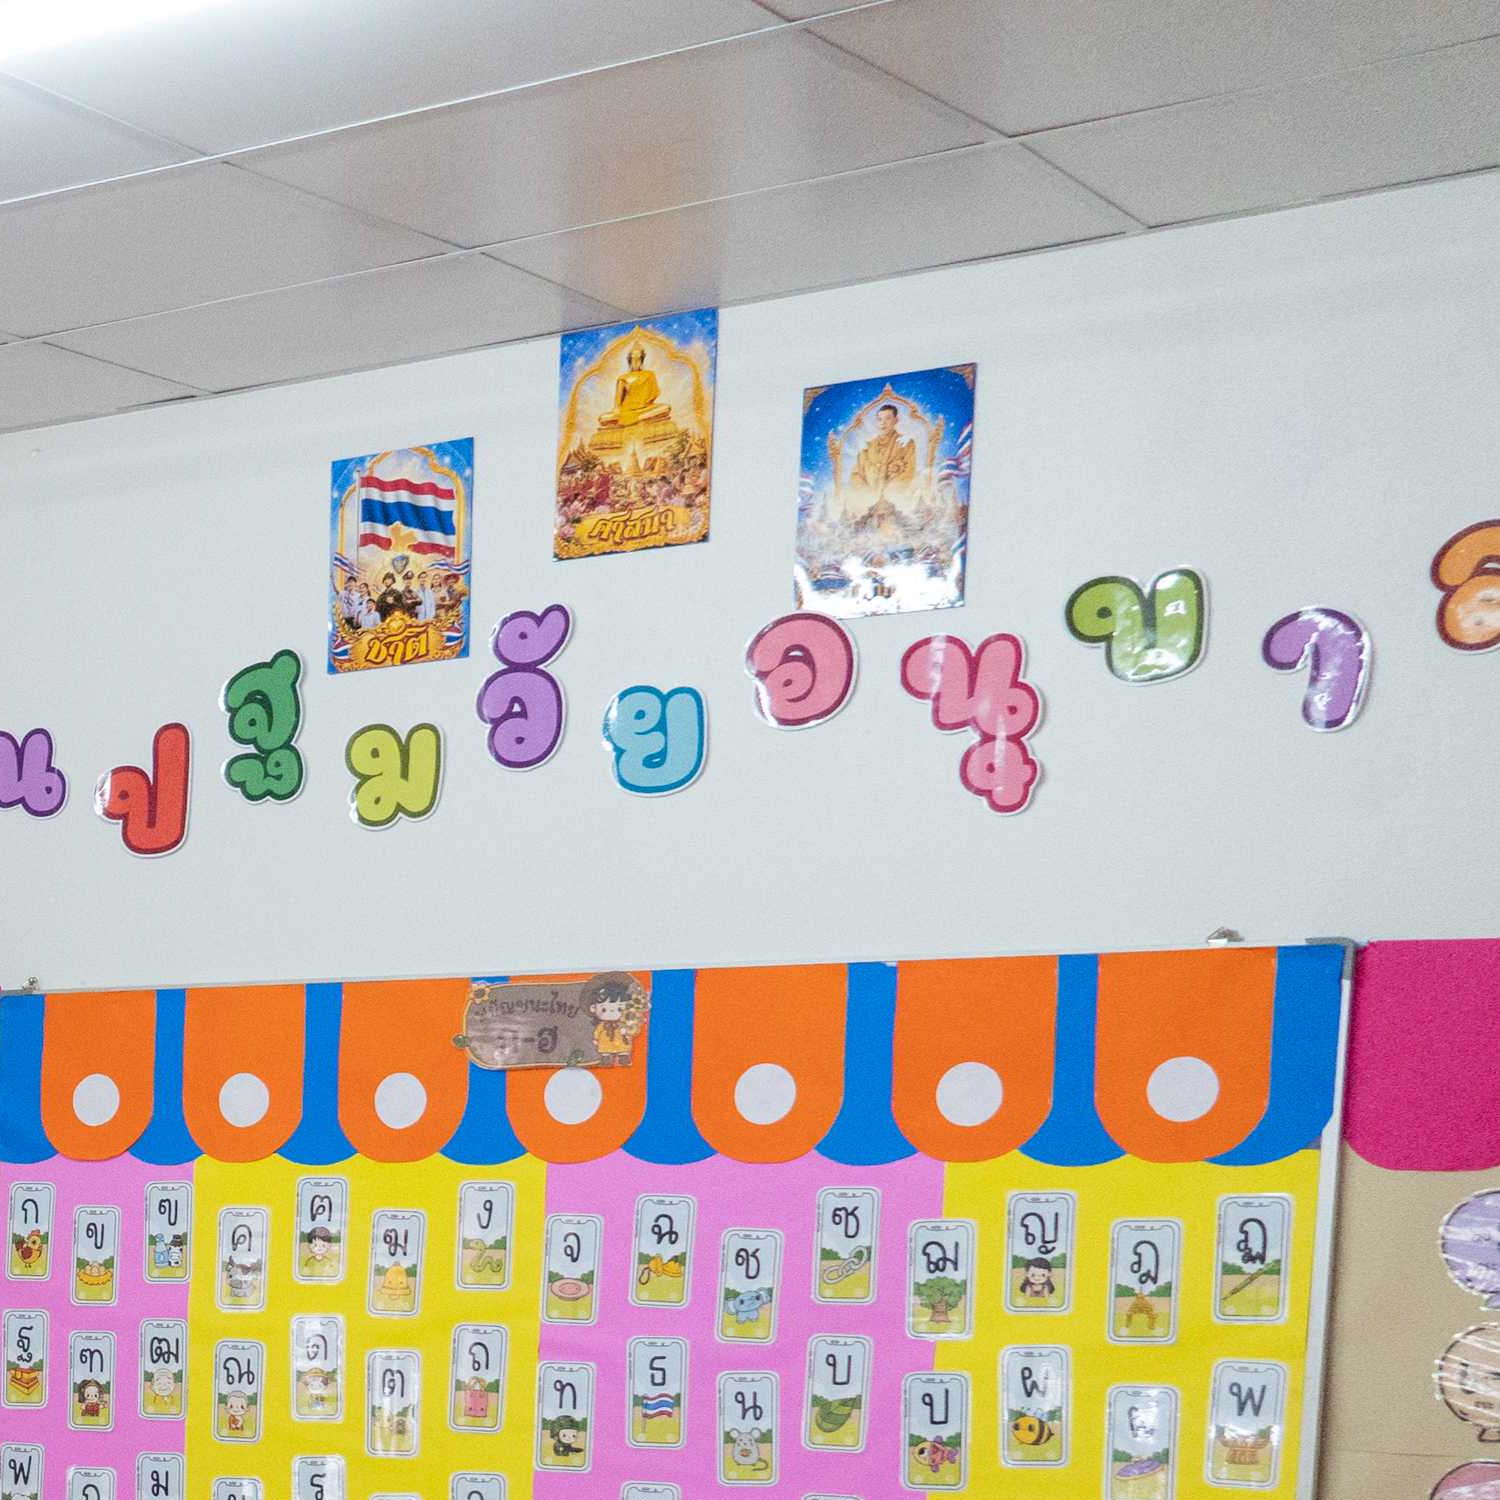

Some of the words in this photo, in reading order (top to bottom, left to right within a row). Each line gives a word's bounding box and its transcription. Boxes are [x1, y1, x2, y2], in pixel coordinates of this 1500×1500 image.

[588, 504, 674, 545] ศาสนา
[365, 623, 429, 665] ชาติ
[22, 1199, 38, 1224] ก
[311, 1195, 332, 1221] ฅ
[478, 1200, 492, 1229] ง
[832, 1207, 859, 1238] ซ
[87, 1223, 104, 1249] ข
[232, 1225, 251, 1251] ค
[384, 1229, 408, 1256] ฆ
[652, 1214, 678, 1244] ฉ
[1021, 1213, 1058, 1255] ญ
[564, 1233, 580, 1262] จ
[922, 1241, 958, 1273] ฌ
[735, 1248, 760, 1279] ช
[17, 1326, 34, 1362] ฐ
[150, 1337, 179, 1364] ฒ
[469, 1342, 489, 1371] ถ
[80, 1349, 103, 1372] ฑ
[224, 1357, 254, 1385] ณ
[650, 1356, 666, 1386] ธ
[826, 1354, 851, 1385] บ
[554, 1380, 576, 1409] ท
[735, 1392, 763, 1420] น
[922, 1389, 948, 1425] ป
[1231, 1383, 1265, 1416] พ
[151, 1471, 168, 1496] ม
[311, 1474, 325, 1500] ร
